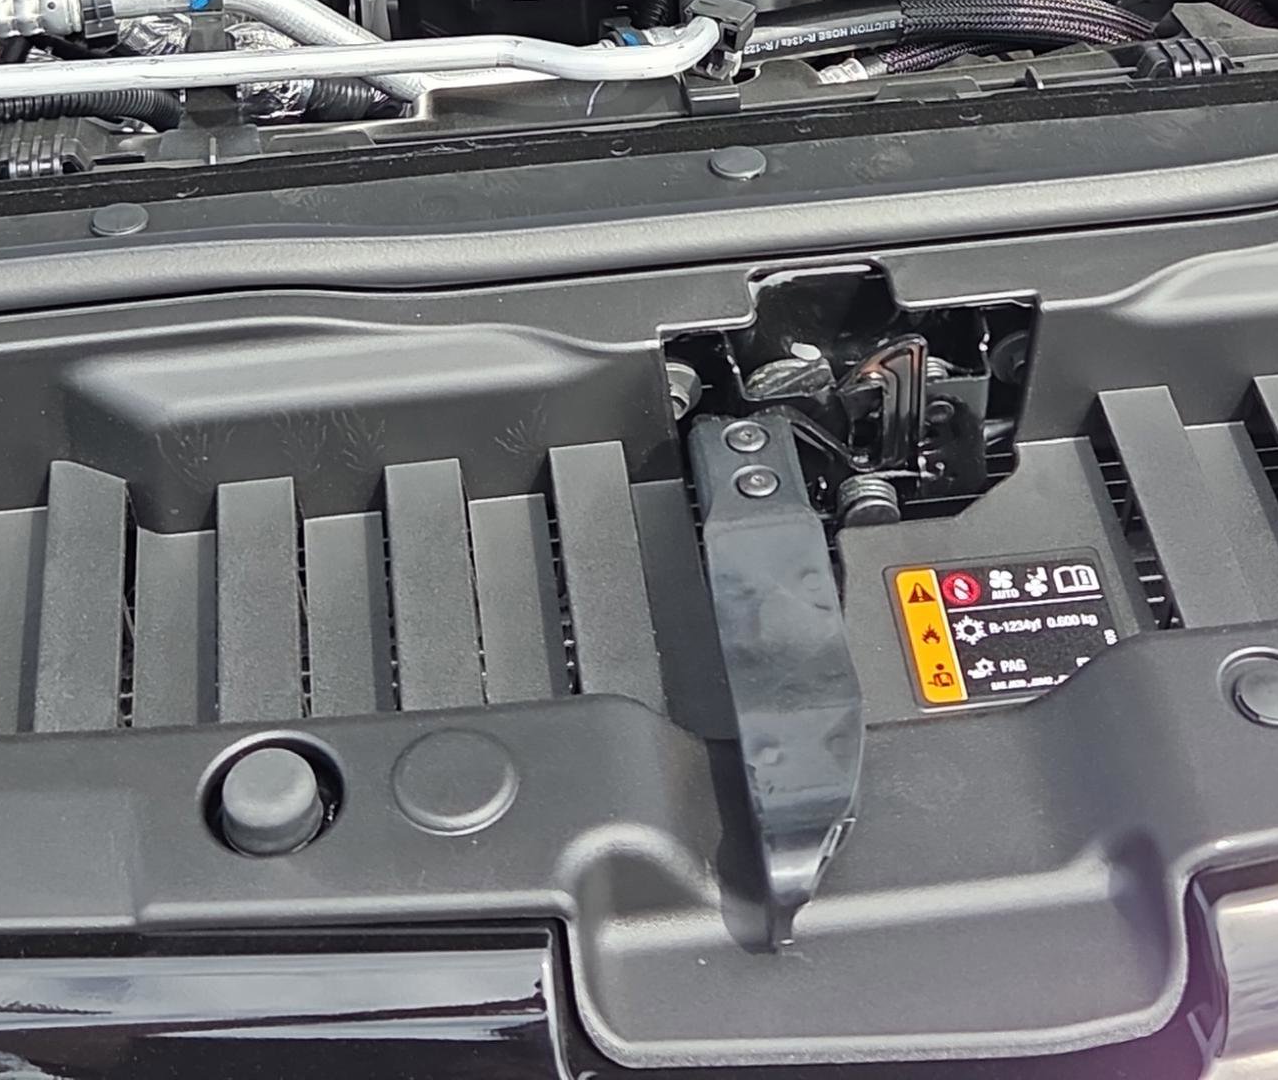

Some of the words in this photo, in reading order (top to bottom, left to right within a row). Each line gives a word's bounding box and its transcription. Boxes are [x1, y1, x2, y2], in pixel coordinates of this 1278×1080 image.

[850, 19, 896, 34] SUCTION
[781, 33, 817, 47] R-134a
[818, 28, 848, 41] HOSE
[743, 41, 774, 55] R-123
[991, 587, 1020, 600] AUTO
[1080, 613, 1098, 626] kg
[1000, 658, 1027, 673] PAG
